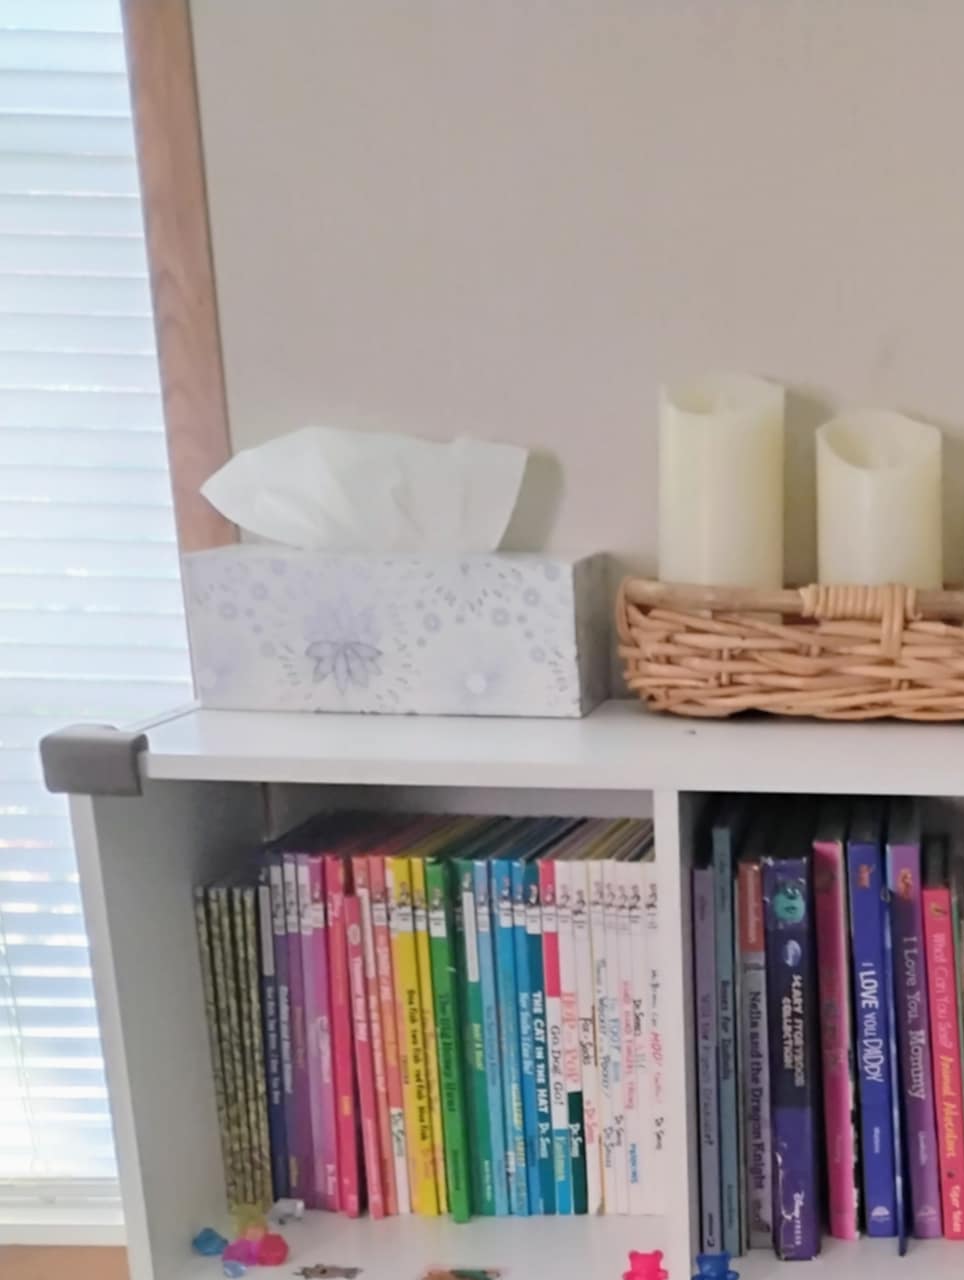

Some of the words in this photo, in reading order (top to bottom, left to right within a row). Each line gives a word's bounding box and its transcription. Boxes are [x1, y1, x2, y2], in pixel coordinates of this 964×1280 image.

[932, 932, 946, 962] What
[903, 948, 920, 987] Love
[934, 966, 948, 993] Can
[532, 991, 543, 1014] THE
[859, 970, 878, 1009] LOVE
[936, 997, 950, 1019] You
[534, 1018, 545, 1042] CAT
[750, 1031, 762, 1059] and
[537, 1063, 546, 1084] THE
[751, 1060, 764, 1085] the
[908, 1027, 927, 1100] Mommy
[538, 1088, 549, 1113] HAT
[749, 1087, 764, 1140] Dragon
[750, 1141, 766, 1190] Knight
